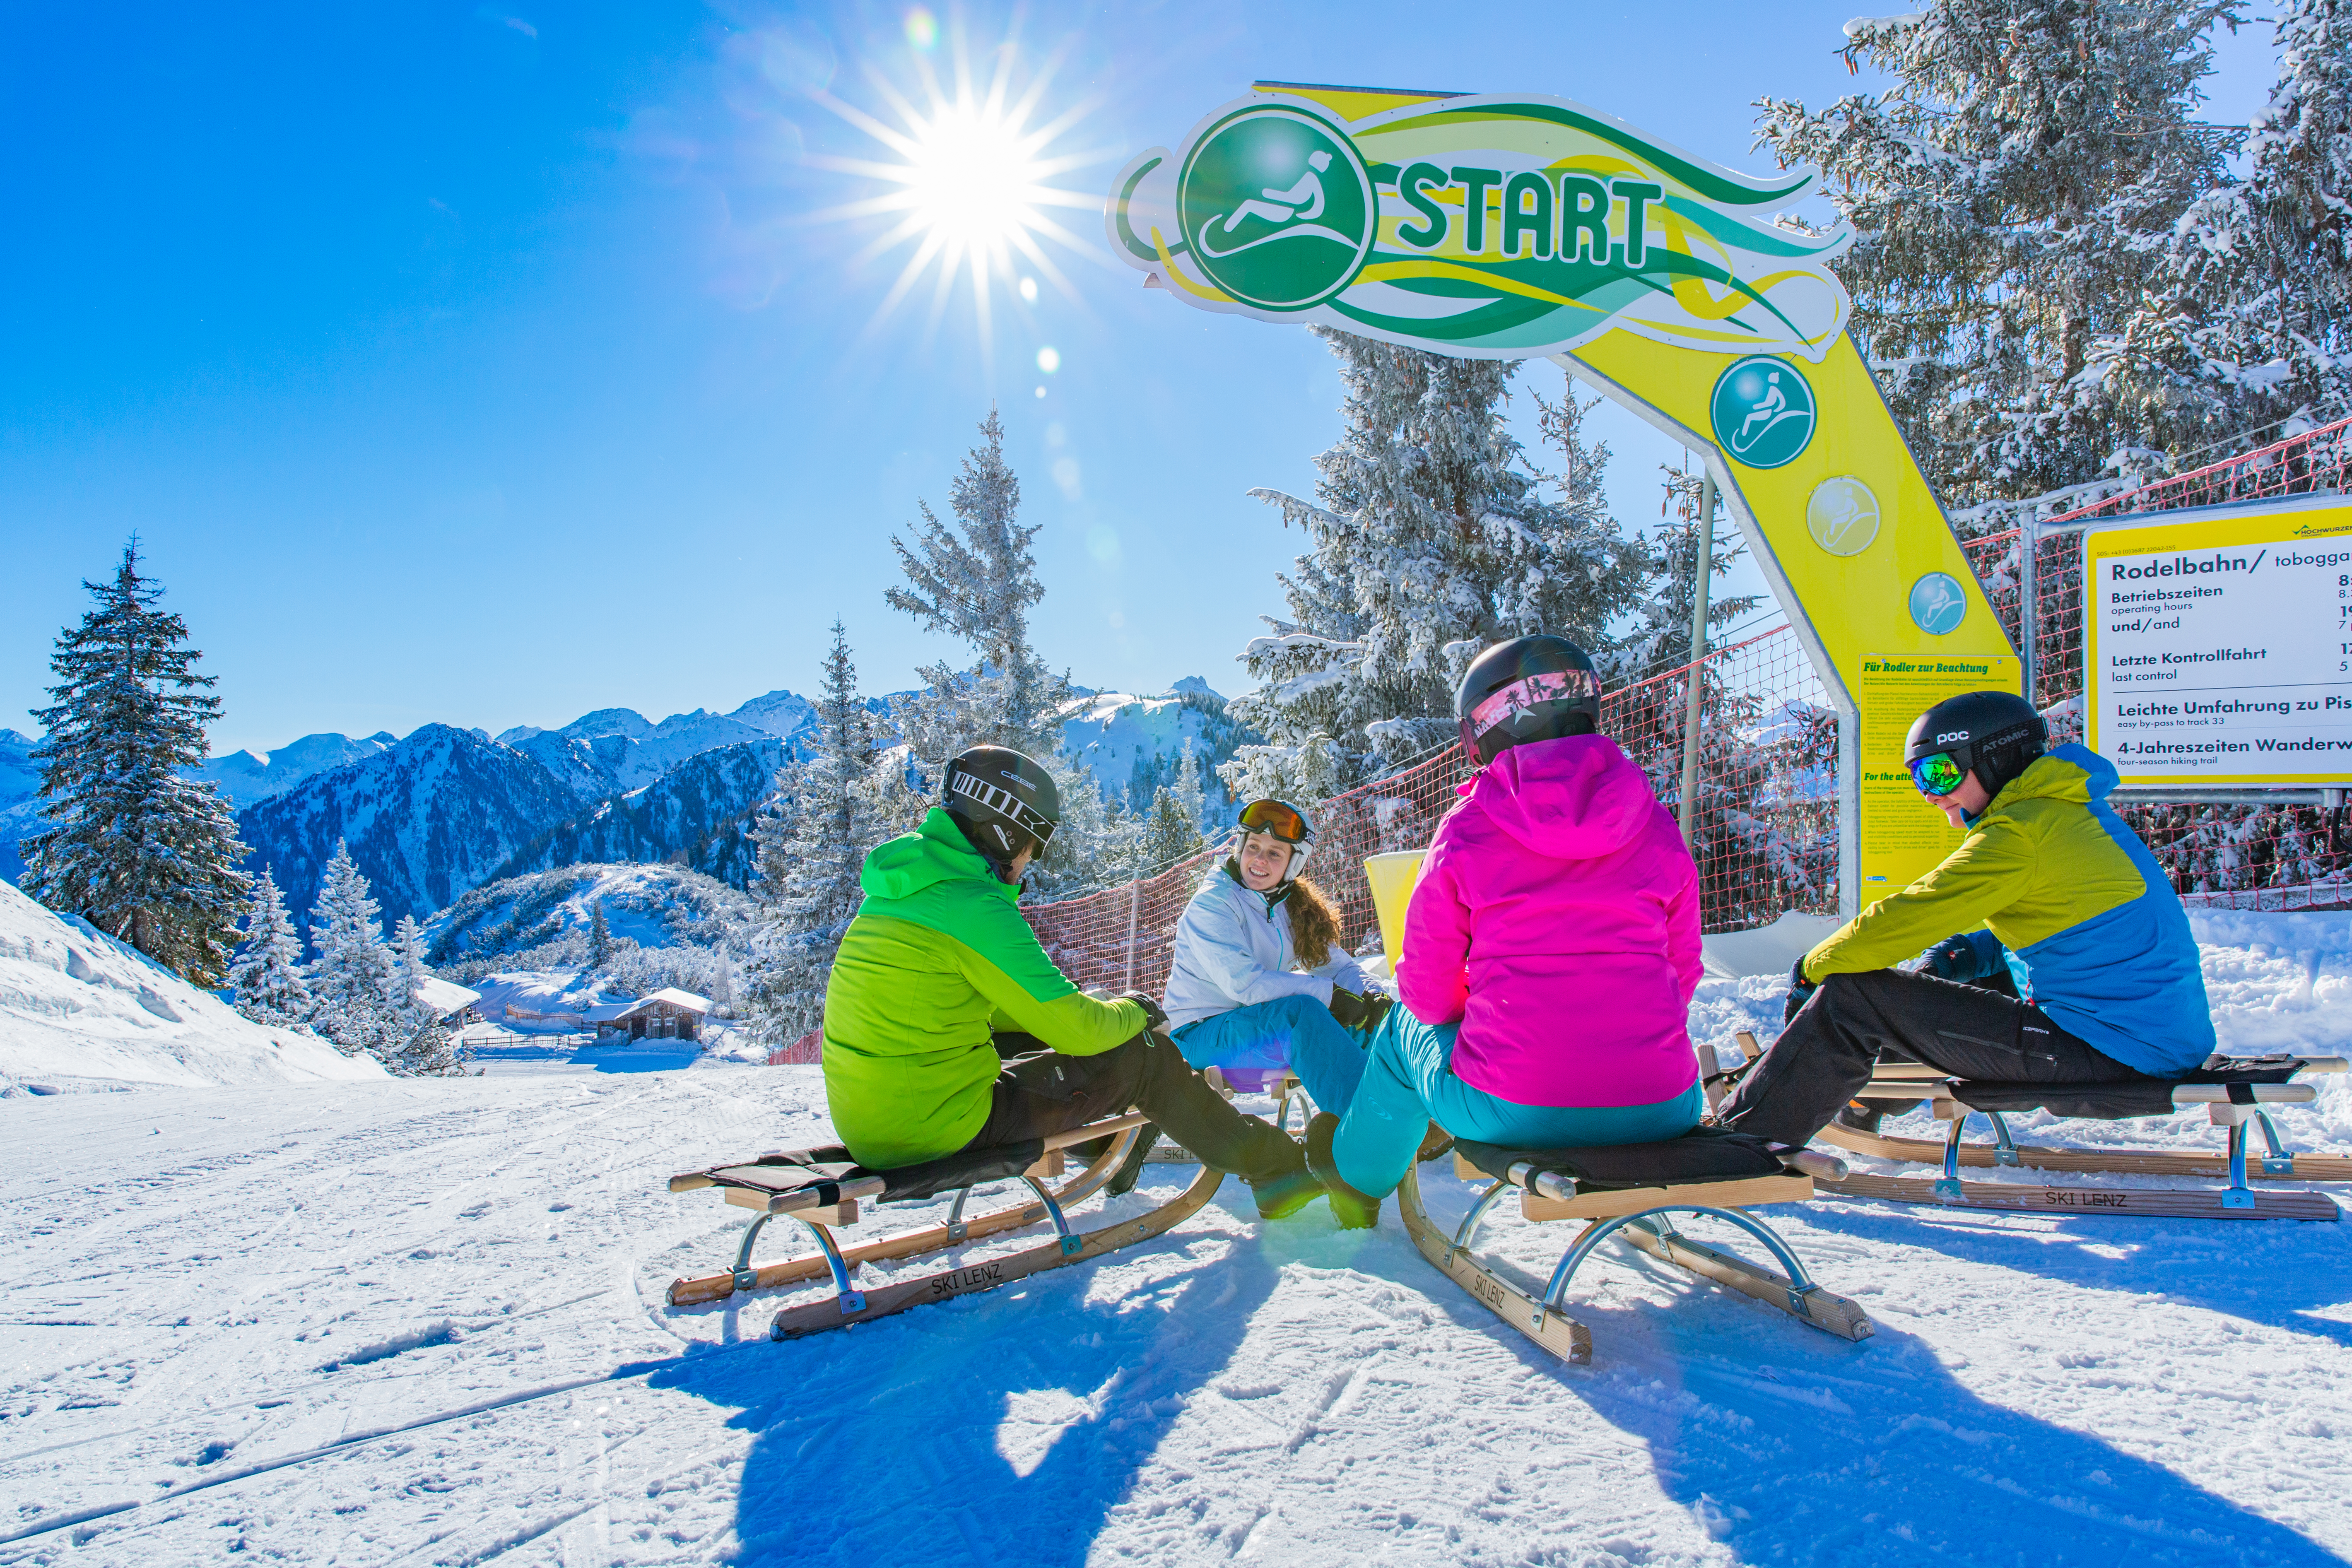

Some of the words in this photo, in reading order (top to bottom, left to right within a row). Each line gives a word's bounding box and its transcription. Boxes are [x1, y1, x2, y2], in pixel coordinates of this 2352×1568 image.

[1398, 162, 1661, 265] START
[2275, 552, 2352, 567] tobogga
[2112, 586, 2223, 603] Betriebszeiten
[2111, 605, 2161, 616] operating
[2164, 602, 2193, 611] hours
[2112, 655, 2157, 666] Letzte
[2162, 648, 2267, 664] Kontrollfahrt
[1863, 662, 1881, 672] Für
[1882, 662, 1916, 672] Rodler
[1935, 663, 1988, 674] Beachtung
[2339, 661, 2348, 671] 5
[2112, 672, 2132, 682] last
[2135, 669, 2177, 681] control
[2118, 703, 2178, 716] Leichte
[2184, 699, 2290, 715] Umfahrung
[2296, 701, 2319, 711] zu
[1474, 703, 1517, 739] NAKED
[2140, 720, 2174, 728] by-pass
[1983, 729, 2029, 753] ATOMIC
[2118, 739, 2249, 754] 4-Jahreszeiten
[2171, 757, 2197, 766] hiking
[1164, 1149, 1184, 1159] SKI
[2046, 1192, 2075, 1204] SKI
[2082, 1193, 2128, 1207] LENZ
[932, 1274, 959, 1294] SKI
[964, 1263, 1002, 1286] LENZ
[1475, 1274, 1487, 1296] SKI
[1487, 1282, 1505, 1309] LENZ
